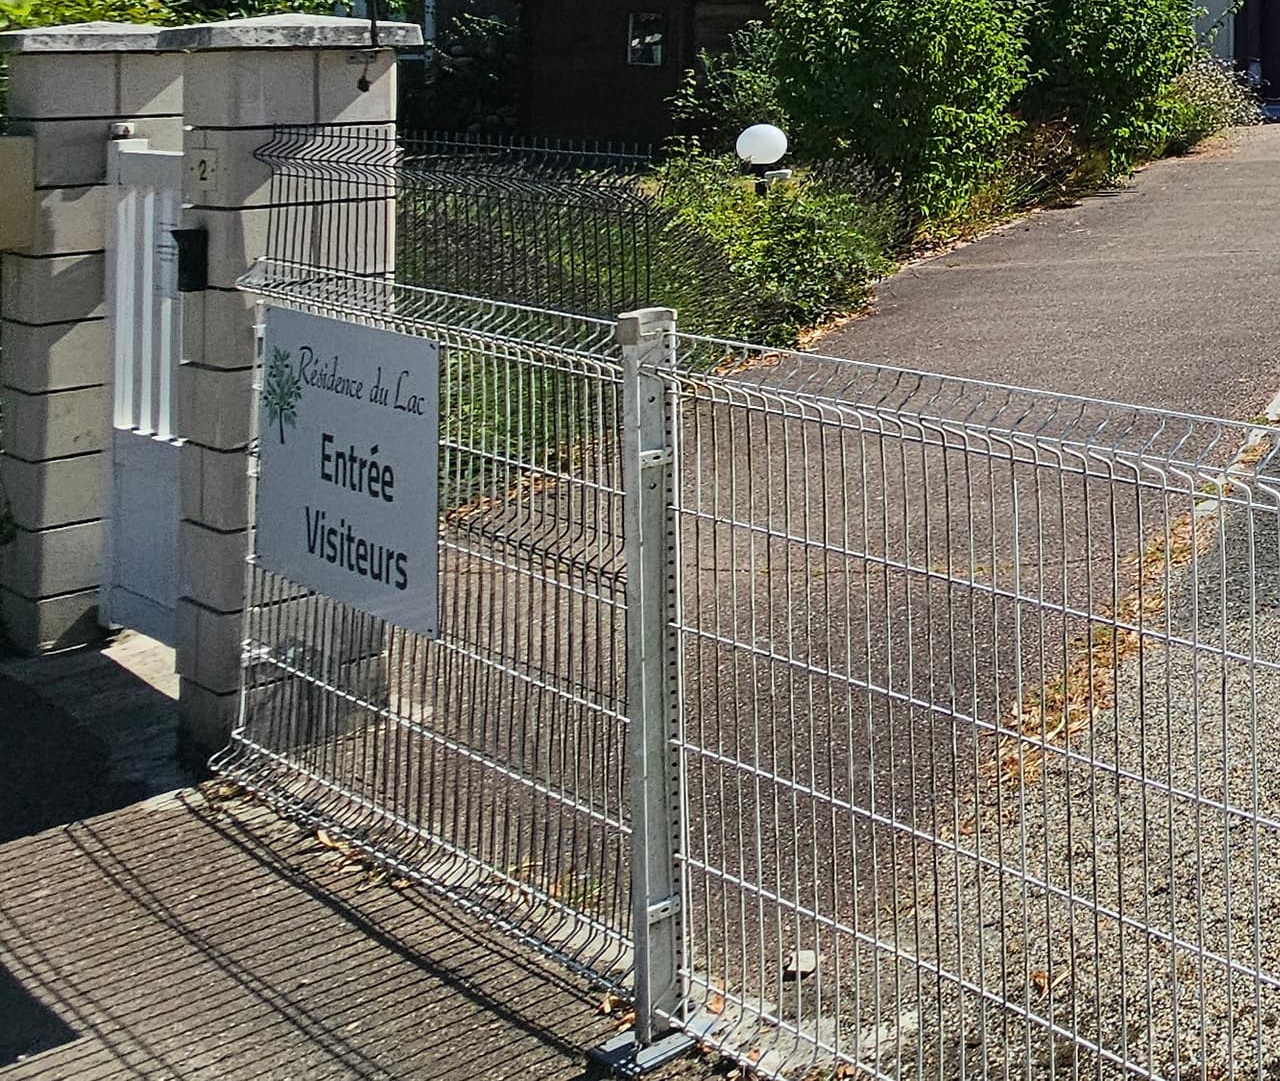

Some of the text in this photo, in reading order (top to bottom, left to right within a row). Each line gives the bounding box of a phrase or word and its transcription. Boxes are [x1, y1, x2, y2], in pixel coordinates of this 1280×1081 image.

[199, 159, 207, 181] 2
[298, 345, 425, 416] Résidence du Lac
[320, 432, 394, 502] Entrée
[305, 506, 408, 590] Visiteurs
